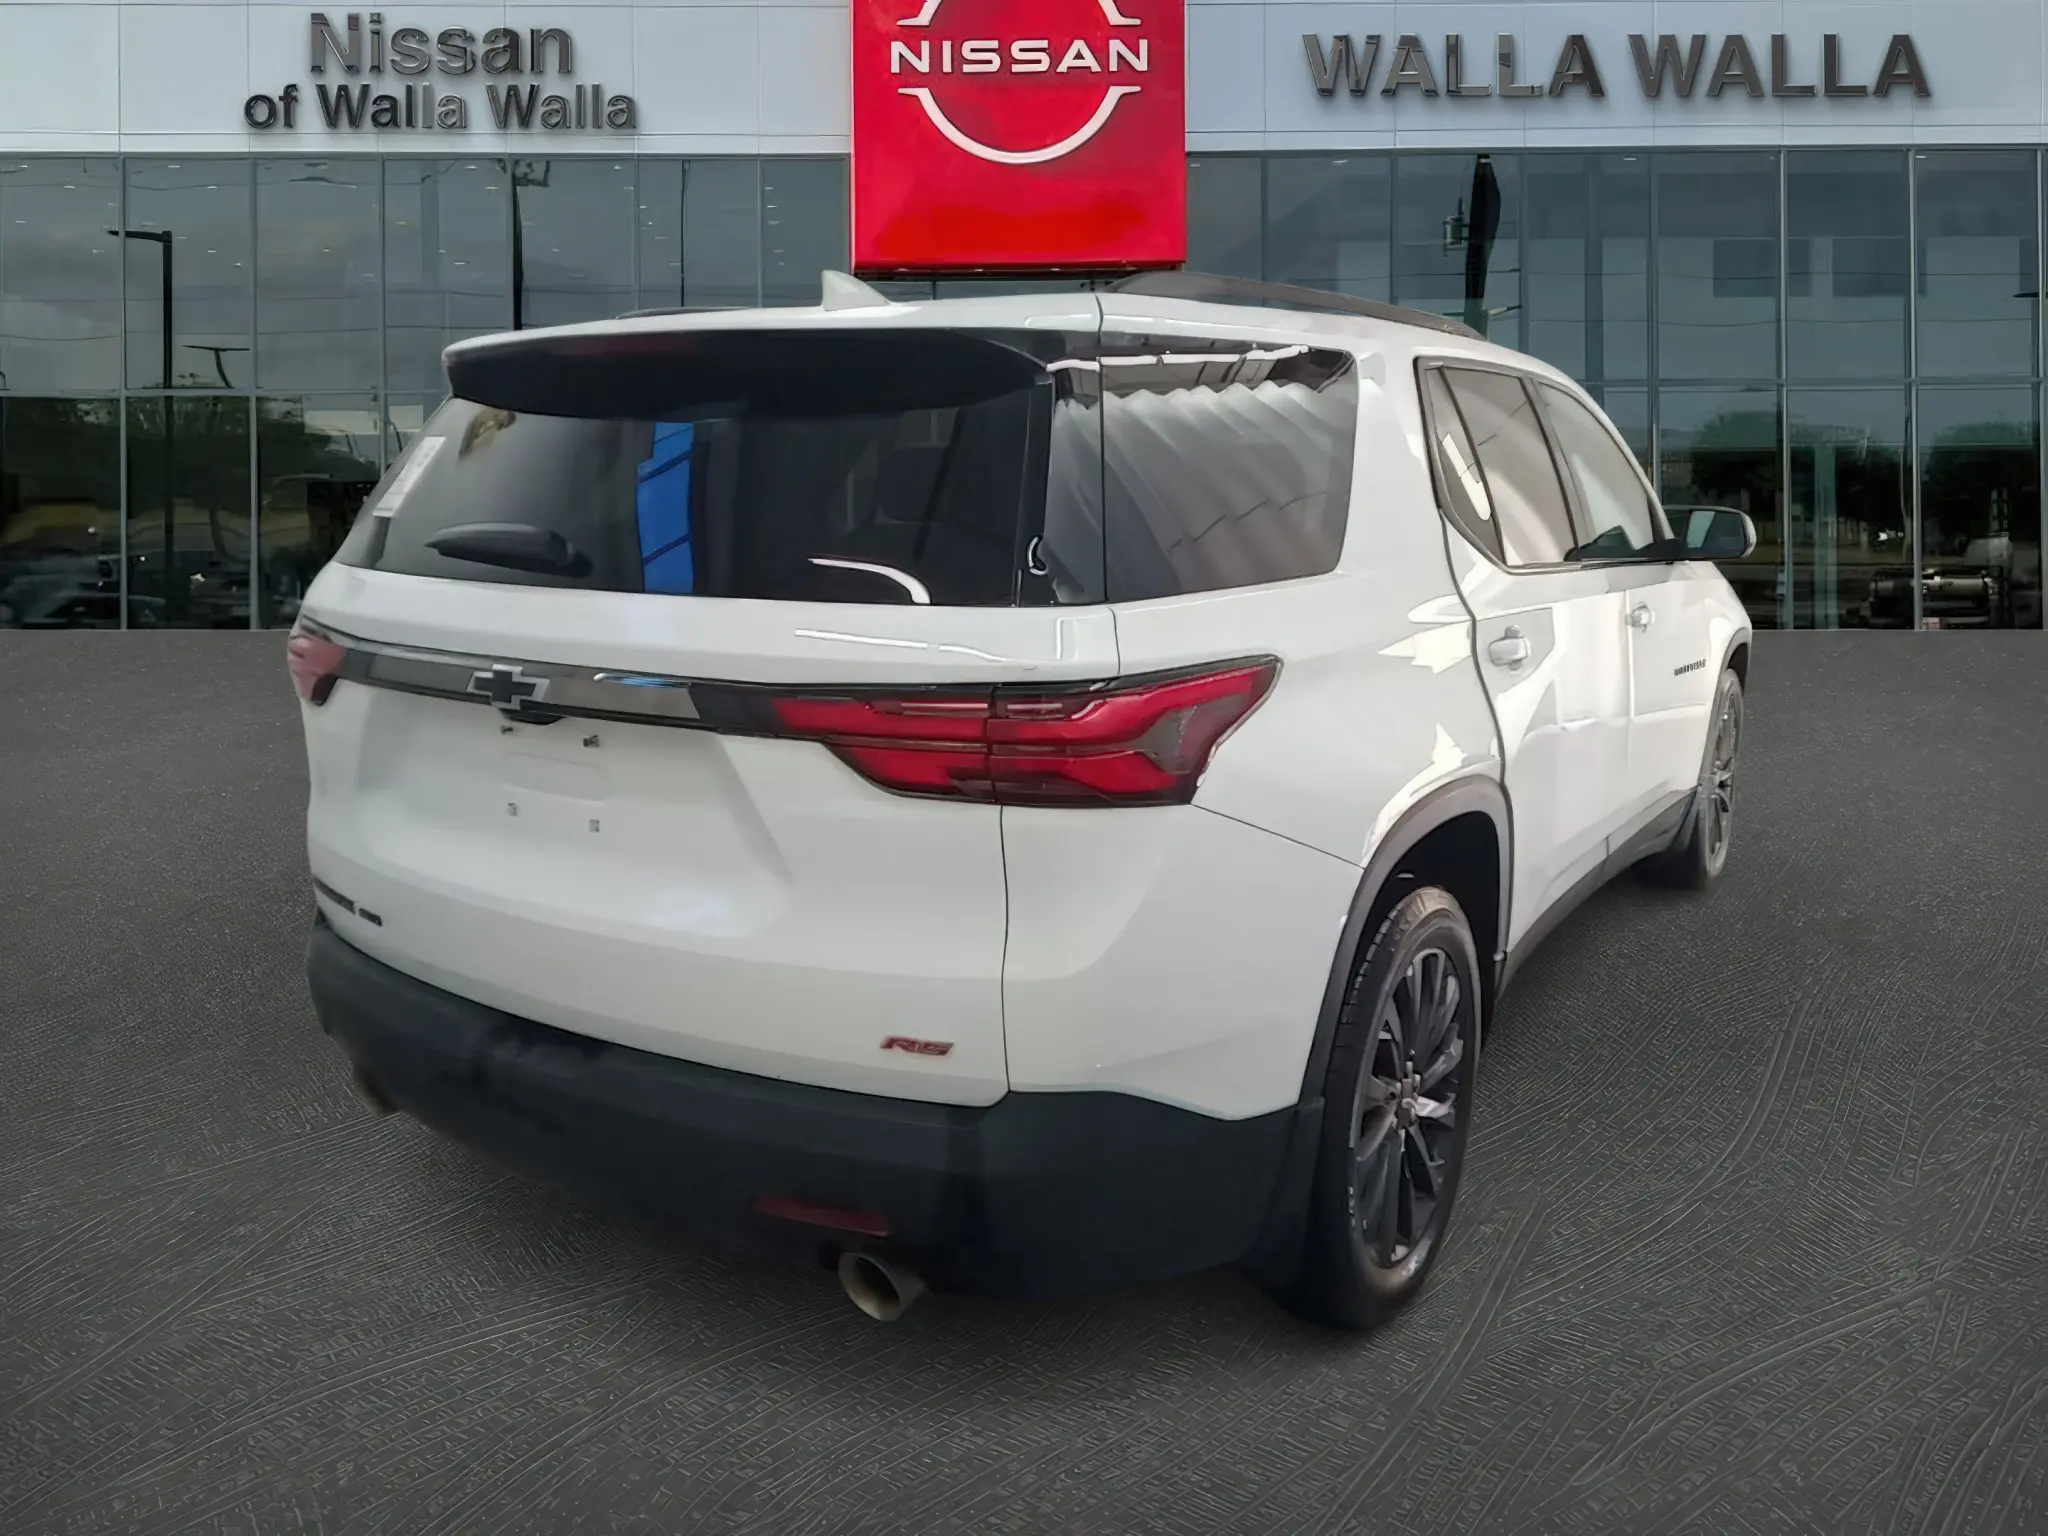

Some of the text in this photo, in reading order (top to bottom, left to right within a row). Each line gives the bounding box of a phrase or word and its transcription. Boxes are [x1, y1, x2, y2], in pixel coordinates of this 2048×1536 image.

[310, 12, 573, 75] Nissan
[890, 39, 1148, 73] NISSAN
[1302, 33, 1932, 97] WALLA WALLA
[244, 82, 637, 129] of Walla Walla
